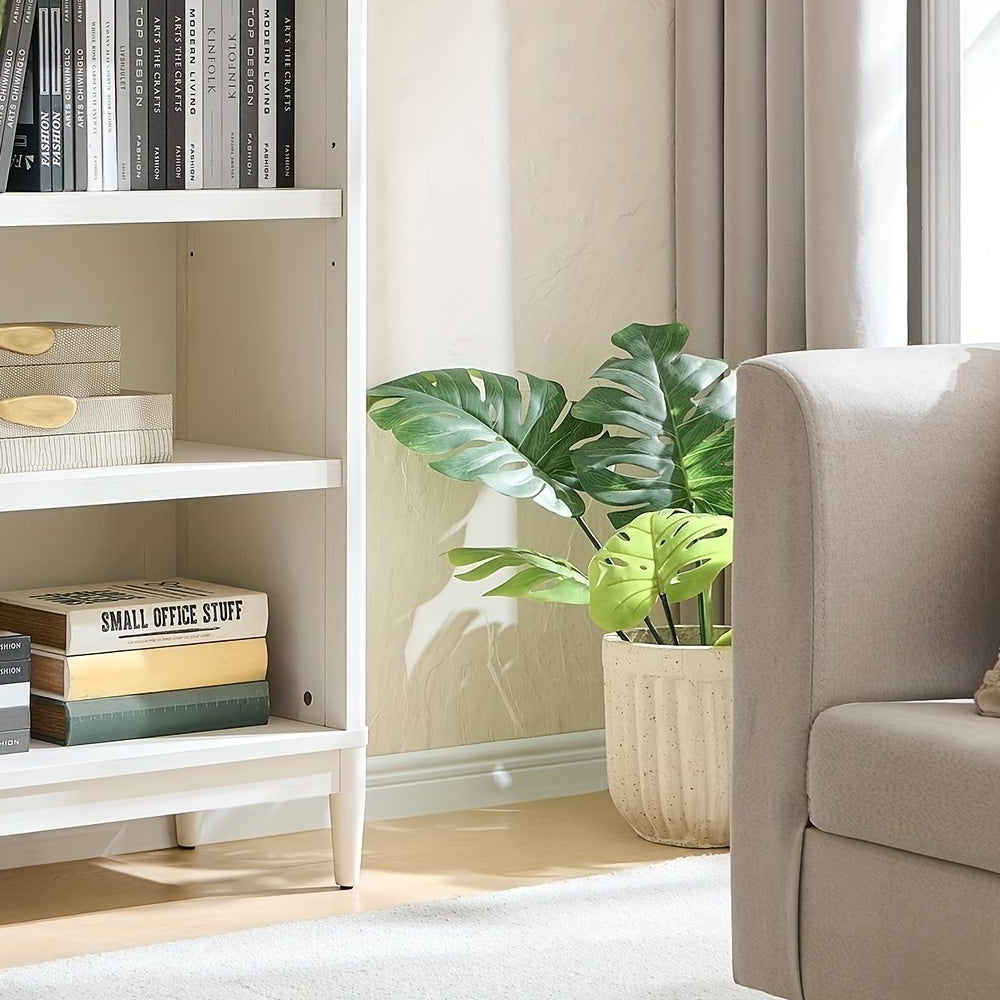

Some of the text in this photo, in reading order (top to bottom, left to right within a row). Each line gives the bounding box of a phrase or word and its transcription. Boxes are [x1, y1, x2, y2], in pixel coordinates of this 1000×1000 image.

[0, 49, 14, 101] CHIWINGLO
[7, 49, 26, 129] ARTS CHIWINGLO
[64, 48, 72, 128] ARTS CHIWINGLO
[135, 7, 144, 108] TOP DESIGN
[153, 16, 161, 114] ARTS THE CRAFTS
[174, 15, 182, 112] ARTS THE CRAFTS
[207, 27, 216, 94] KINFOLK
[227, 33, 237, 99] KINFOLK
[246, 7, 255, 107] TOP DESIGN
[40, 111, 50, 167] FASHION
[52, 111, 62, 167] FASHION
[101, 599, 243, 633] SMALL OFFICE STUFF
